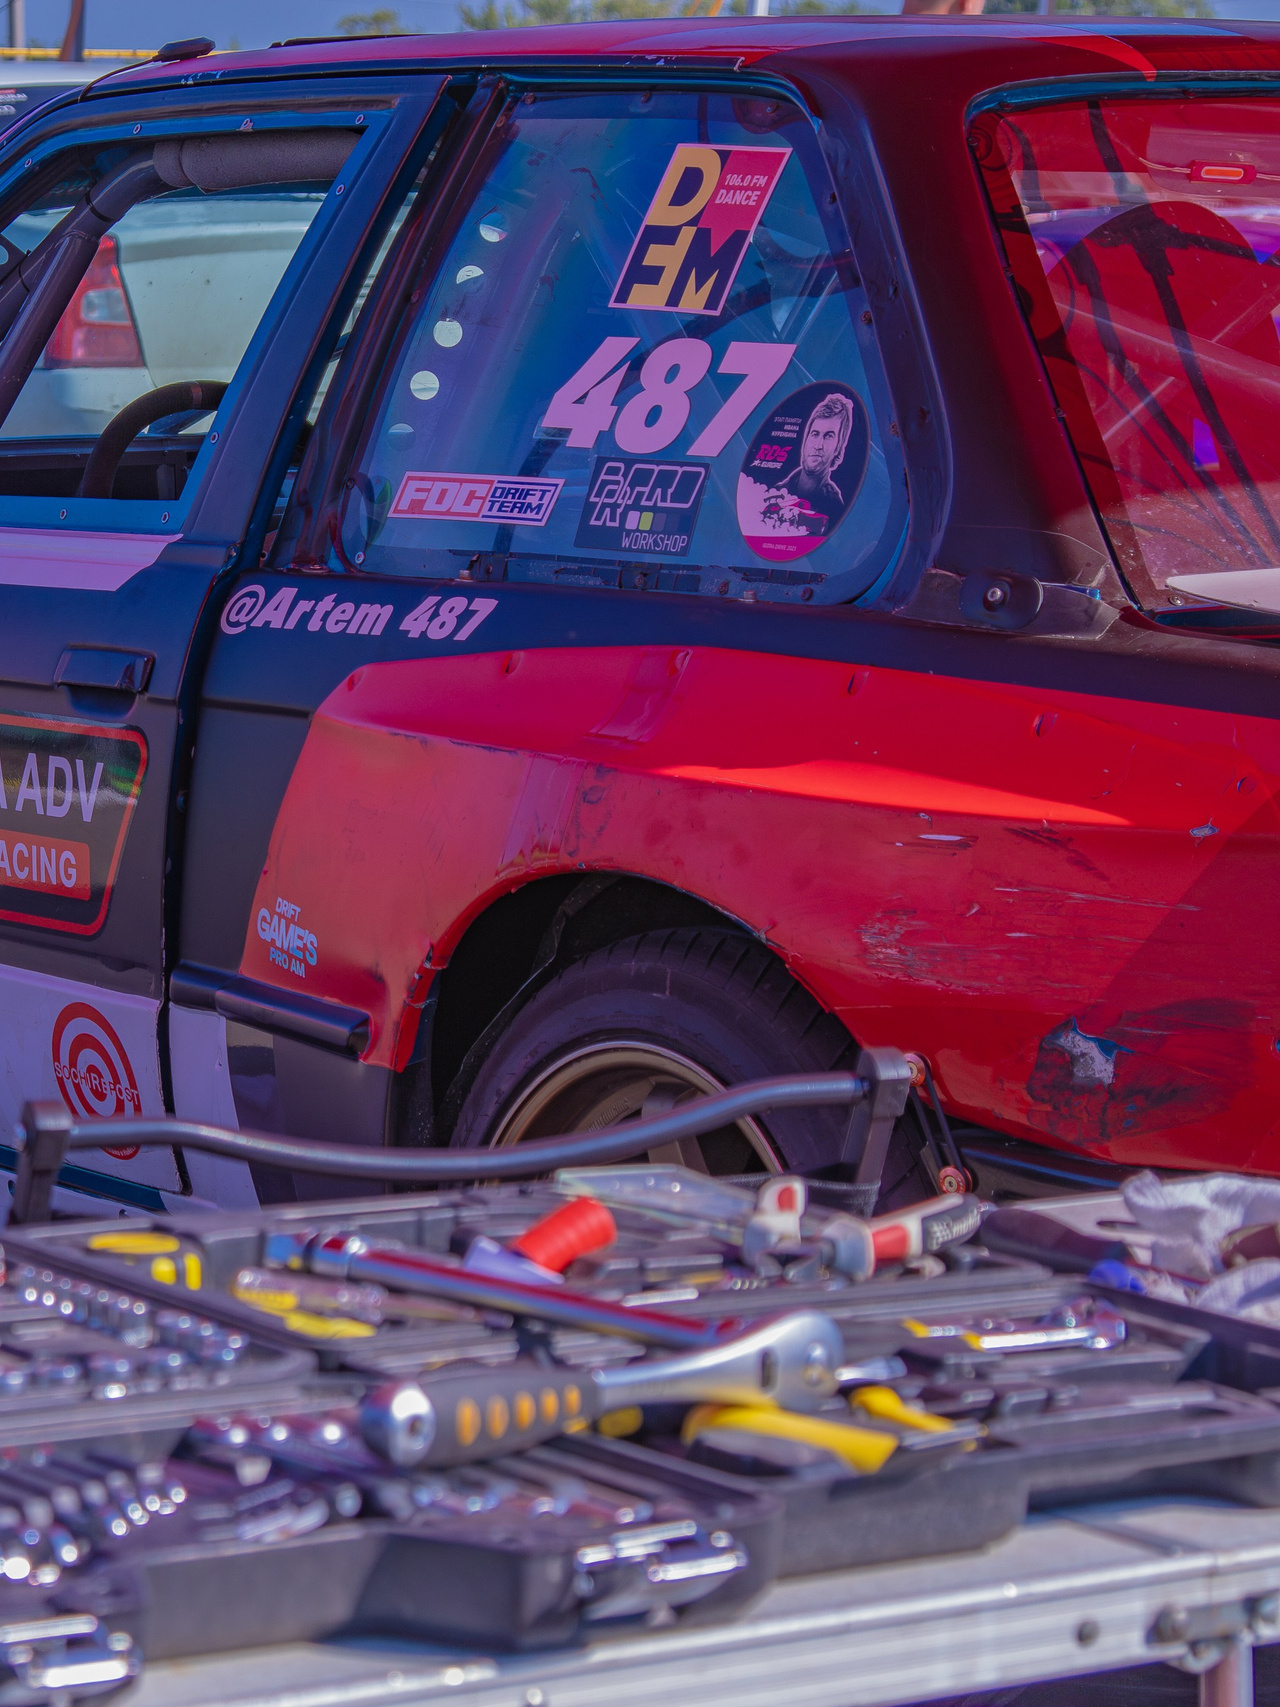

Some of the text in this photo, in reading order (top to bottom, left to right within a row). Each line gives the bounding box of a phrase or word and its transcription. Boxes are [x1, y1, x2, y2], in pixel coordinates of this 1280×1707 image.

[724, 174, 768, 188] 106.0 FM
[715, 189, 761, 206] DANCE
[542, 336, 797, 458] 487
[755, 444, 793, 462] RDS
[397, 480, 491, 514] FDC
[487, 500, 544, 516] TEAM
[490, 486, 552, 502] DRIFT
[622, 531, 688, 553] WORKSHOP
[220, 584, 499, 641] @Artem 487
[14, 752, 105, 823] ADV
[275, 896, 301, 922] DRIFT
[257, 907, 318, 966] GAME'S
[269, 946, 306, 979] PRO AM
[54, 1061, 138, 1105] SOCHIREPOST
